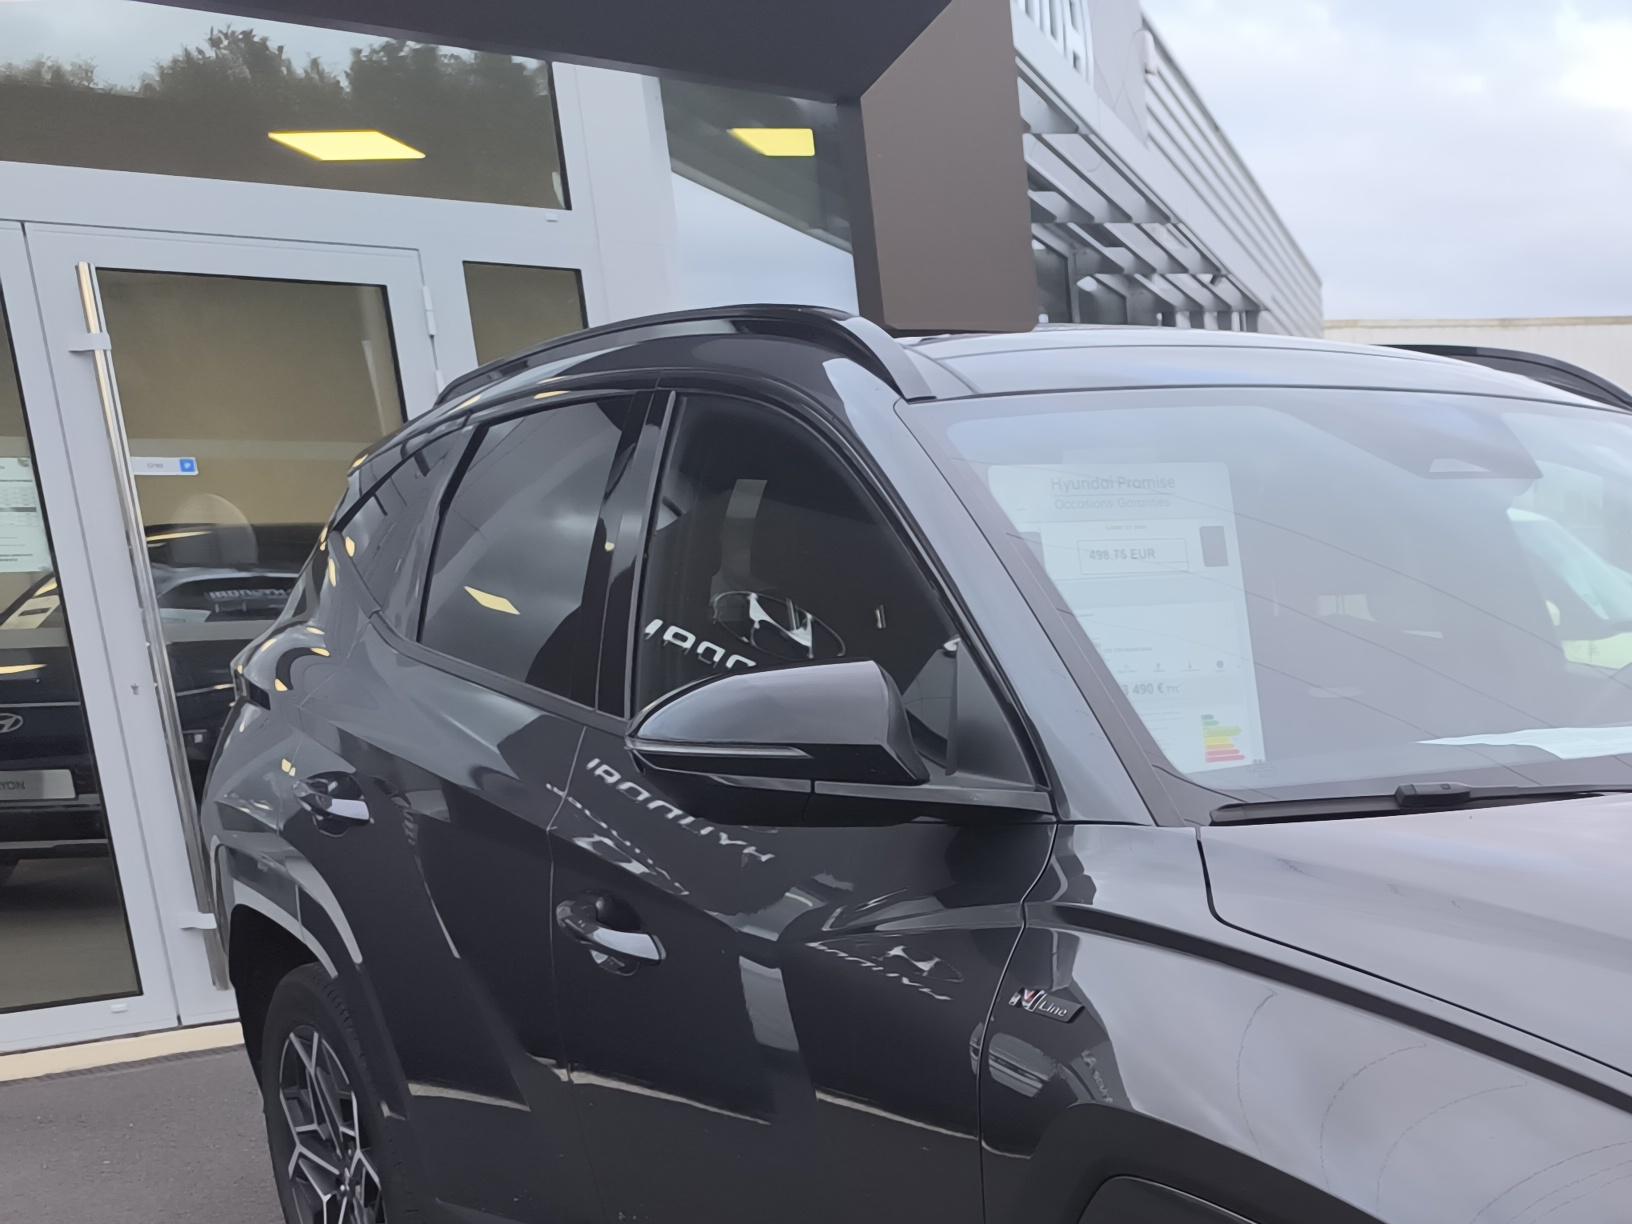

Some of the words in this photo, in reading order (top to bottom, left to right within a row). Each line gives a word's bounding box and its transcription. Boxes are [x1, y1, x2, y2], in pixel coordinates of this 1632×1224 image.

[1050, 475, 1114, 493] Hyundai
[1117, 474, 1175, 489] Promise
[1130, 548, 1156, 559] EUR
[1132, 682, 1154, 695] 490
[1038, 1000, 1068, 1017] Line
